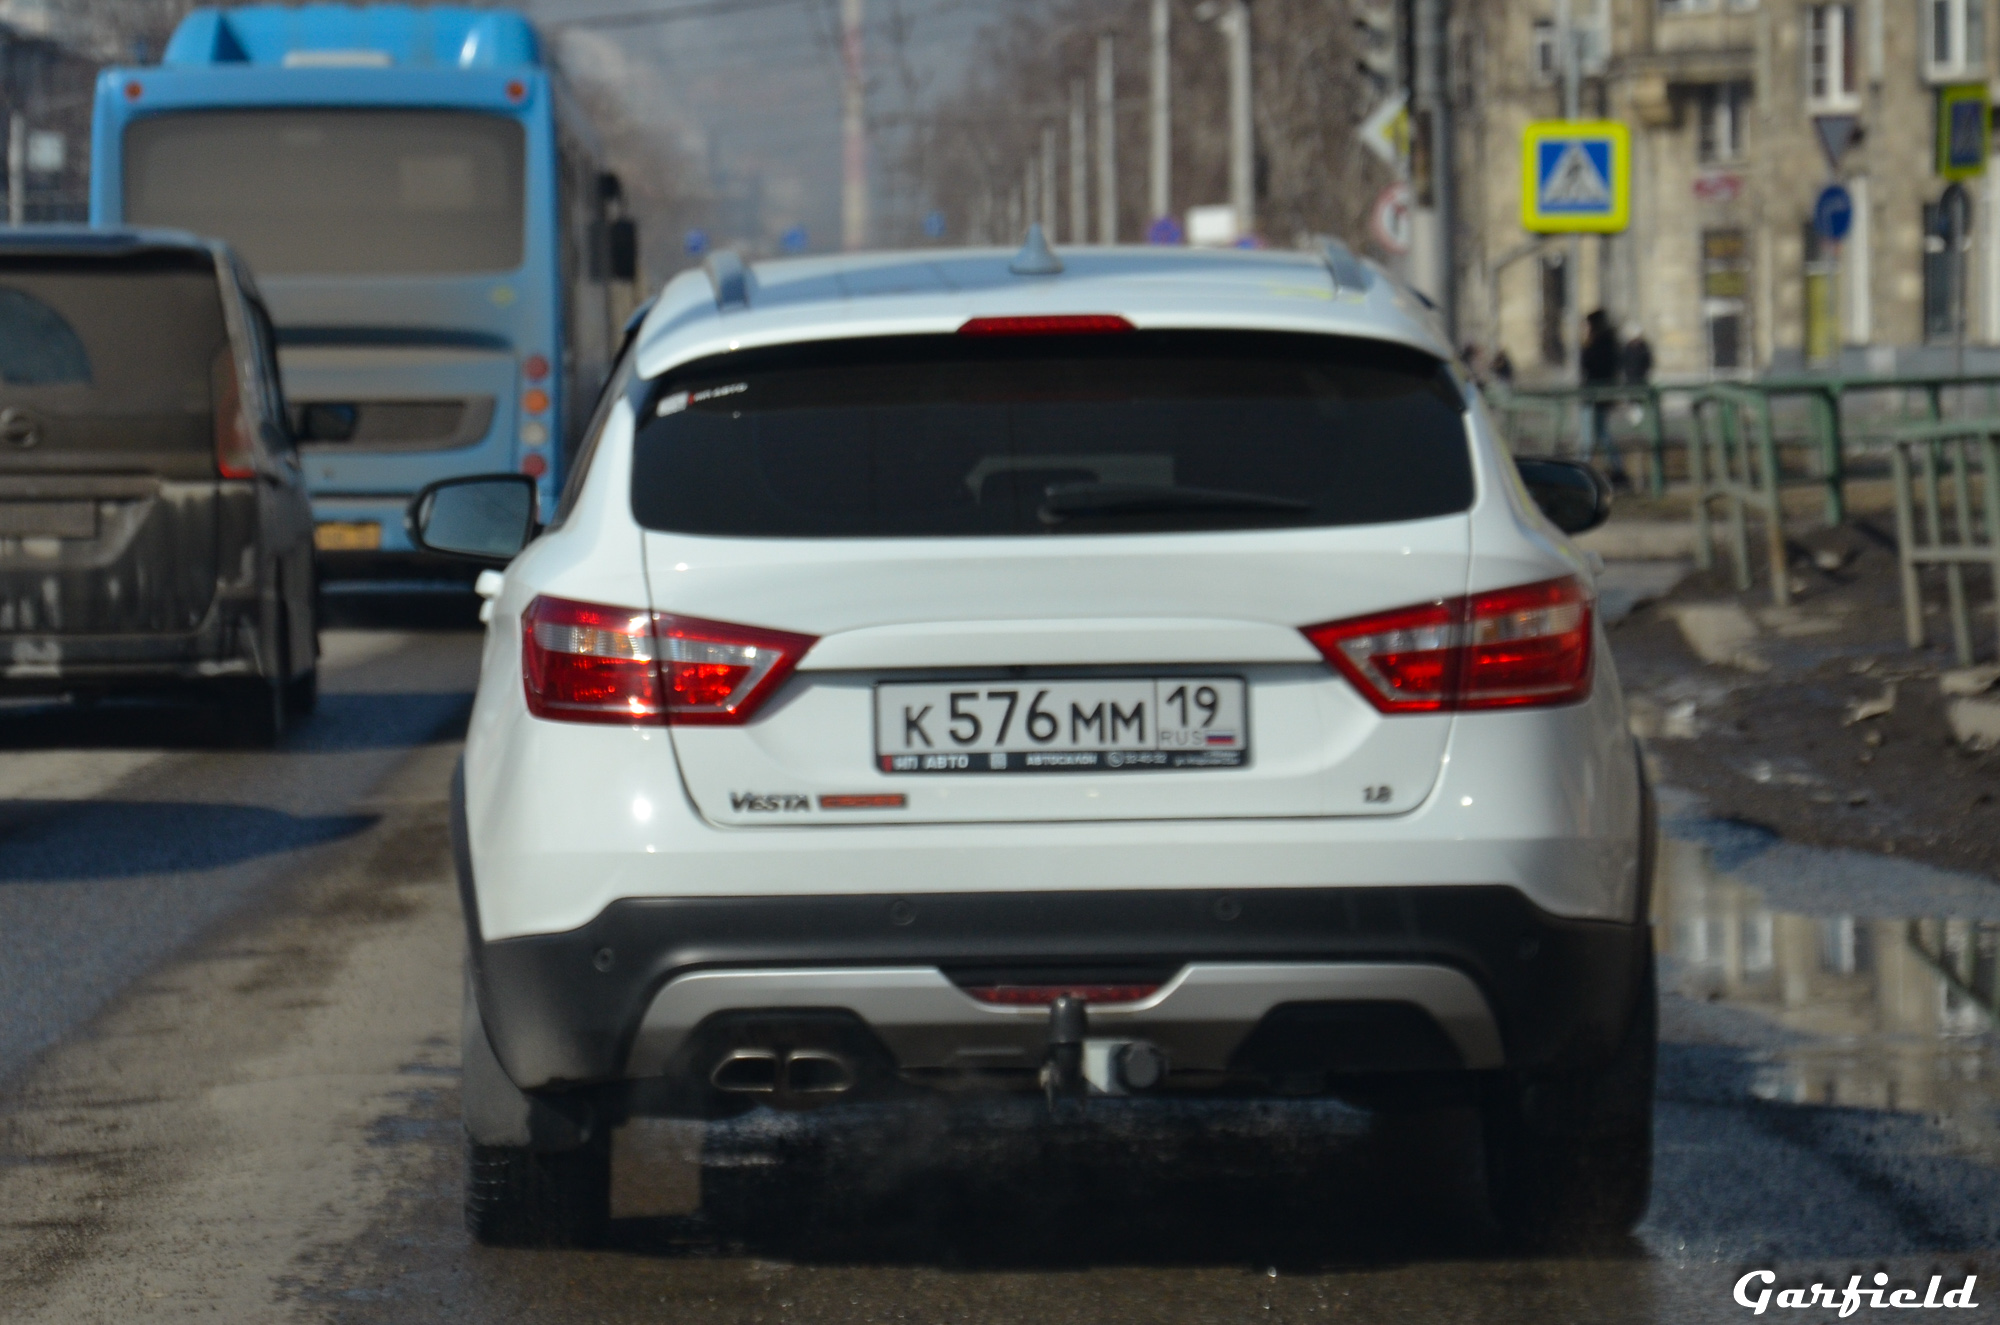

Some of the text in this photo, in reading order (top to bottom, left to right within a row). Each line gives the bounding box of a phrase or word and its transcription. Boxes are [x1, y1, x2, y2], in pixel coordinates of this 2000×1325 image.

[1166, 686, 1219, 728] 19
[1160, 731, 1203, 746] RUS
[924, 754, 969, 769] АВТО
